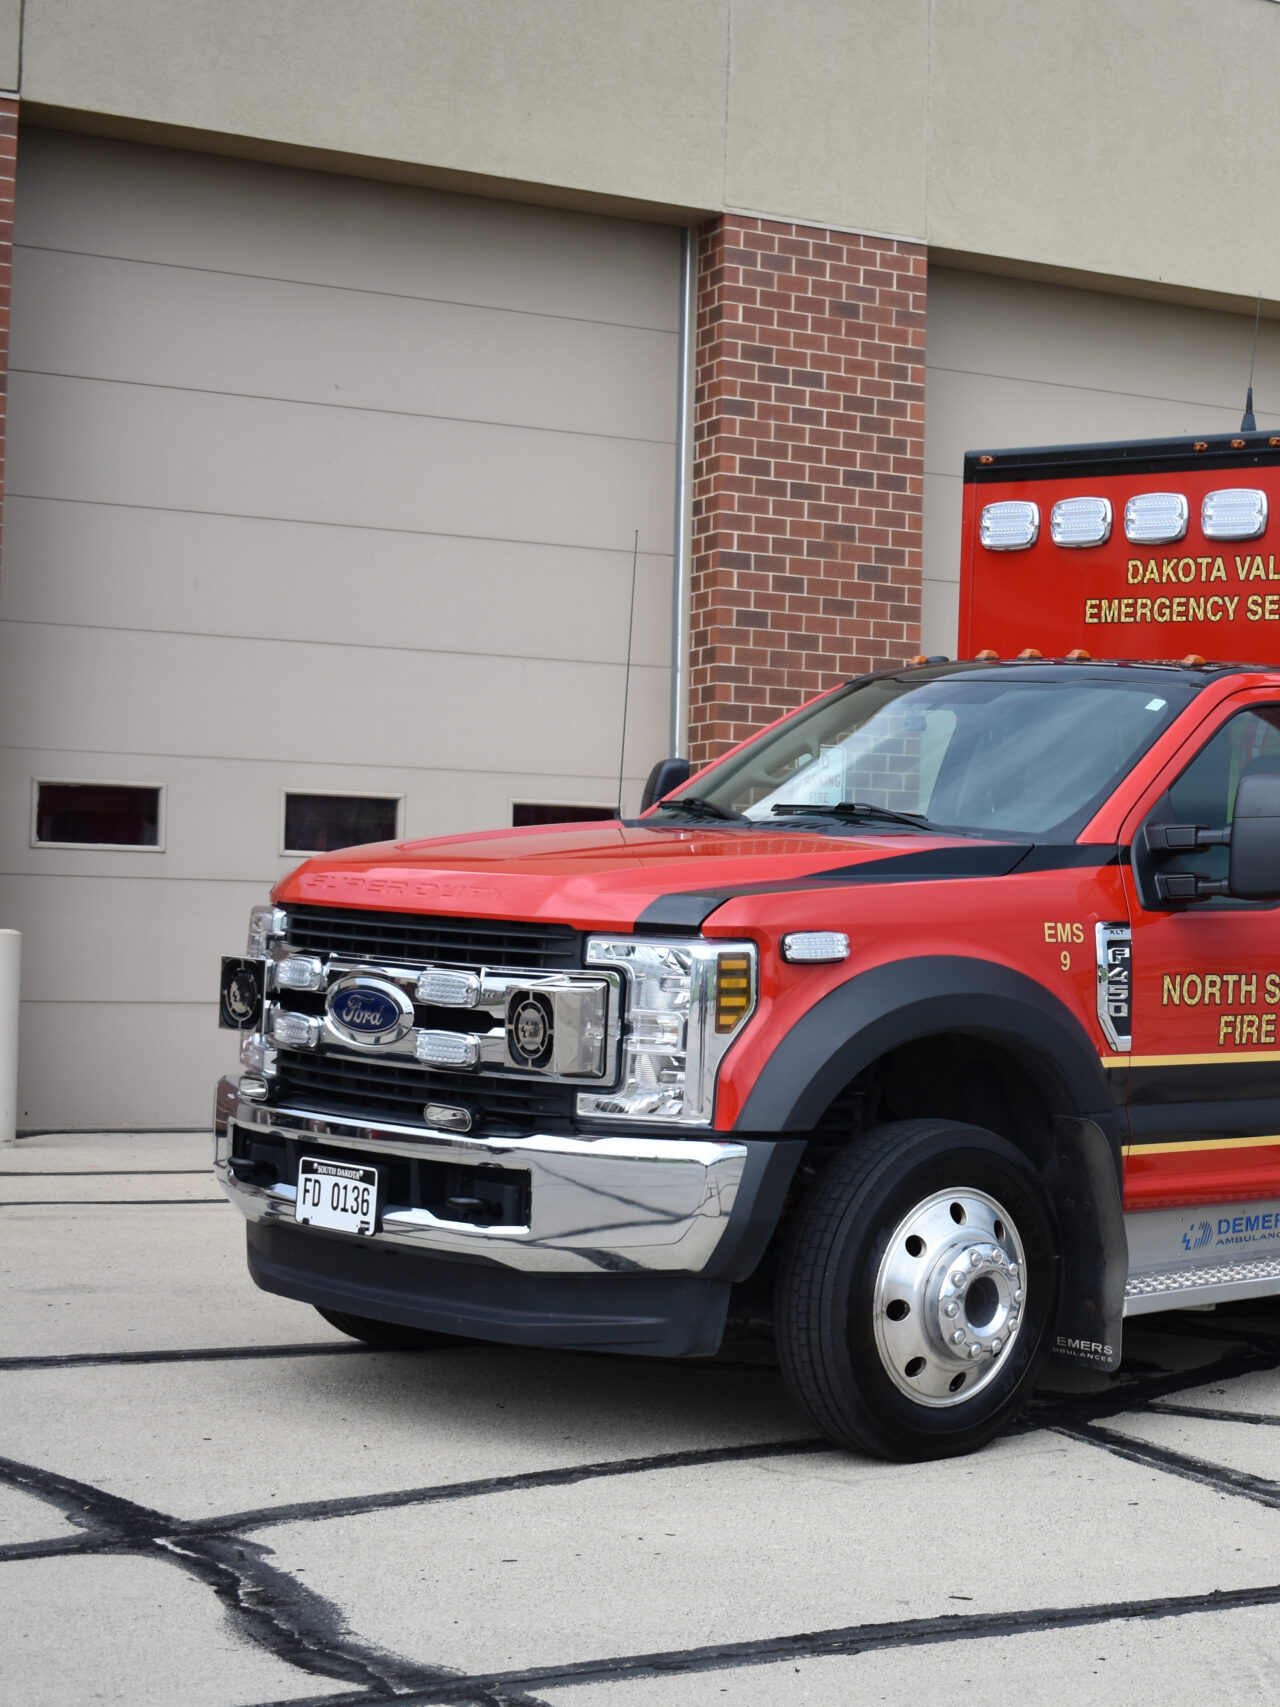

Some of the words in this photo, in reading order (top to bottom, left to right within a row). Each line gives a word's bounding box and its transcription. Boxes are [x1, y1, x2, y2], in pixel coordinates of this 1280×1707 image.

[1126, 556, 1228, 585] DAKOTA
[1084, 595, 1240, 624] EMERGENCY
[306, 874, 409, 894] SUPER
[1044, 922, 1085, 944] EMS
[1060, 950, 1071, 972] 9
[1162, 973, 1257, 1006] NORTH
[342, 994, 385, 1025] Ford
[1218, 1013, 1277, 1046] FIRE
[317, 1165, 336, 1175] SOUTH
[336, 1167, 360, 1179] DAKOTA
[302, 1177, 321, 1207] FD
[331, 1182, 370, 1216] 0136
[1052, 1347, 1113, 1363] MBULANCES
[1056, 1336, 1113, 1355] EMERS
